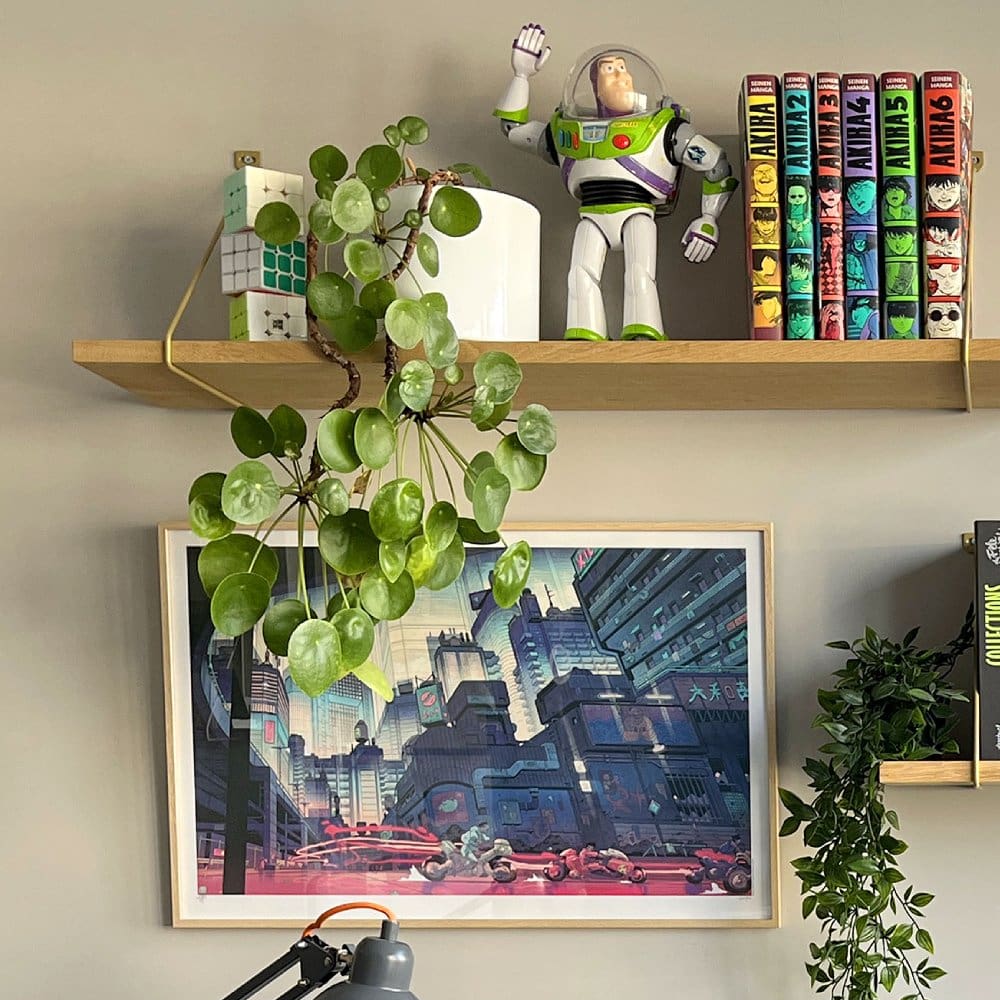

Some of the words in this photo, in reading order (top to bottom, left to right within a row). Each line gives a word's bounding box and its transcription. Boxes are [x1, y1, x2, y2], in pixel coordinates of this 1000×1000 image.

[750, 103, 776, 156] AKIRA
[786, 111, 809, 168] AKIRA
[818, 112, 840, 169] AKIRA
[847, 113, 872, 170] AKIRA
[885, 113, 910, 169] AKIRA
[929, 111, 955, 167] AKIRA
